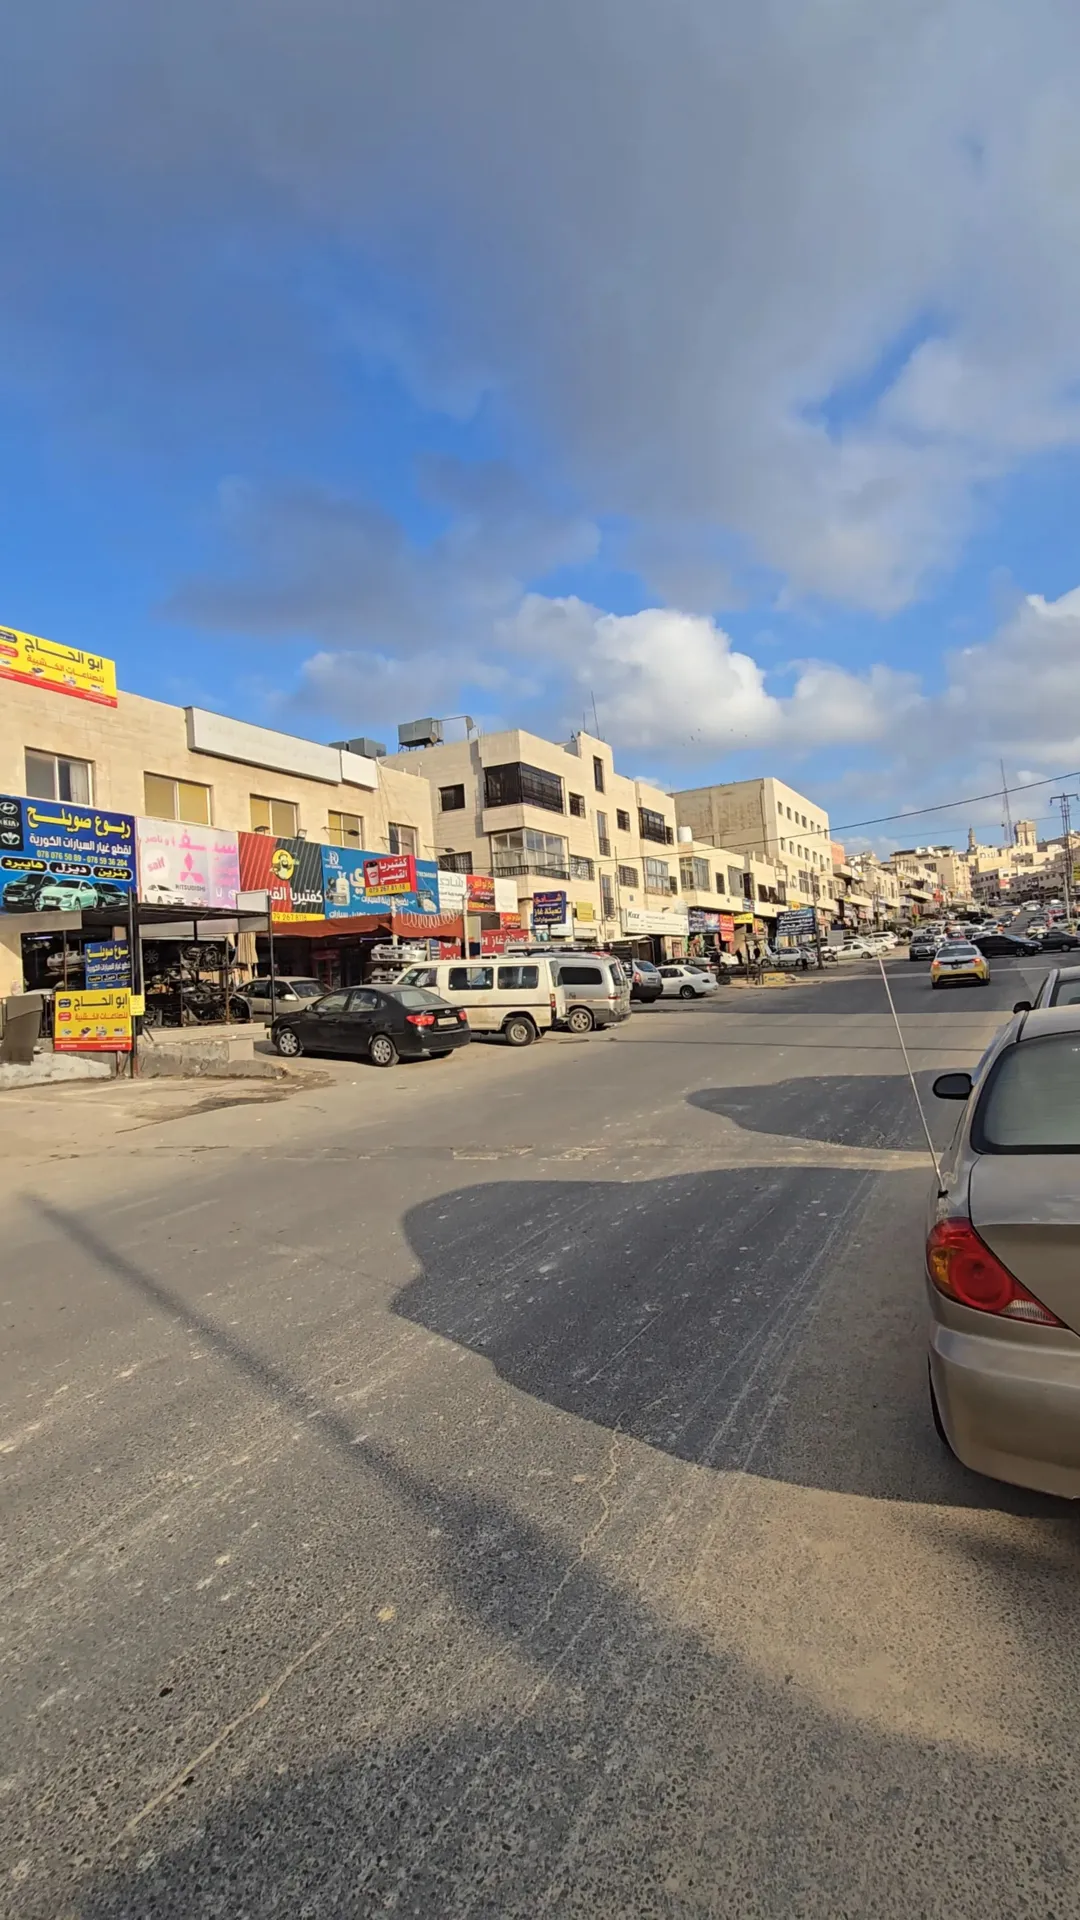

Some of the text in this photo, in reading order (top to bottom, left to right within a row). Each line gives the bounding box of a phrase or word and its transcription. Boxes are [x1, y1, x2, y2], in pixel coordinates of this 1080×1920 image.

[25, 638, 84, 664] الحاج
[87, 658, 103, 672] ابو
[27, 806, 131, 839] ربوع صويلح
[29, 833, 132, 855] لقطع غيار السيارات الكورية
[55, 863, 87, 874] ديزل
[267, 887, 323, 905] كفتيريا القي
[73, 994, 113, 1012] الحاج
[115, 993, 128, 1009] ابو
